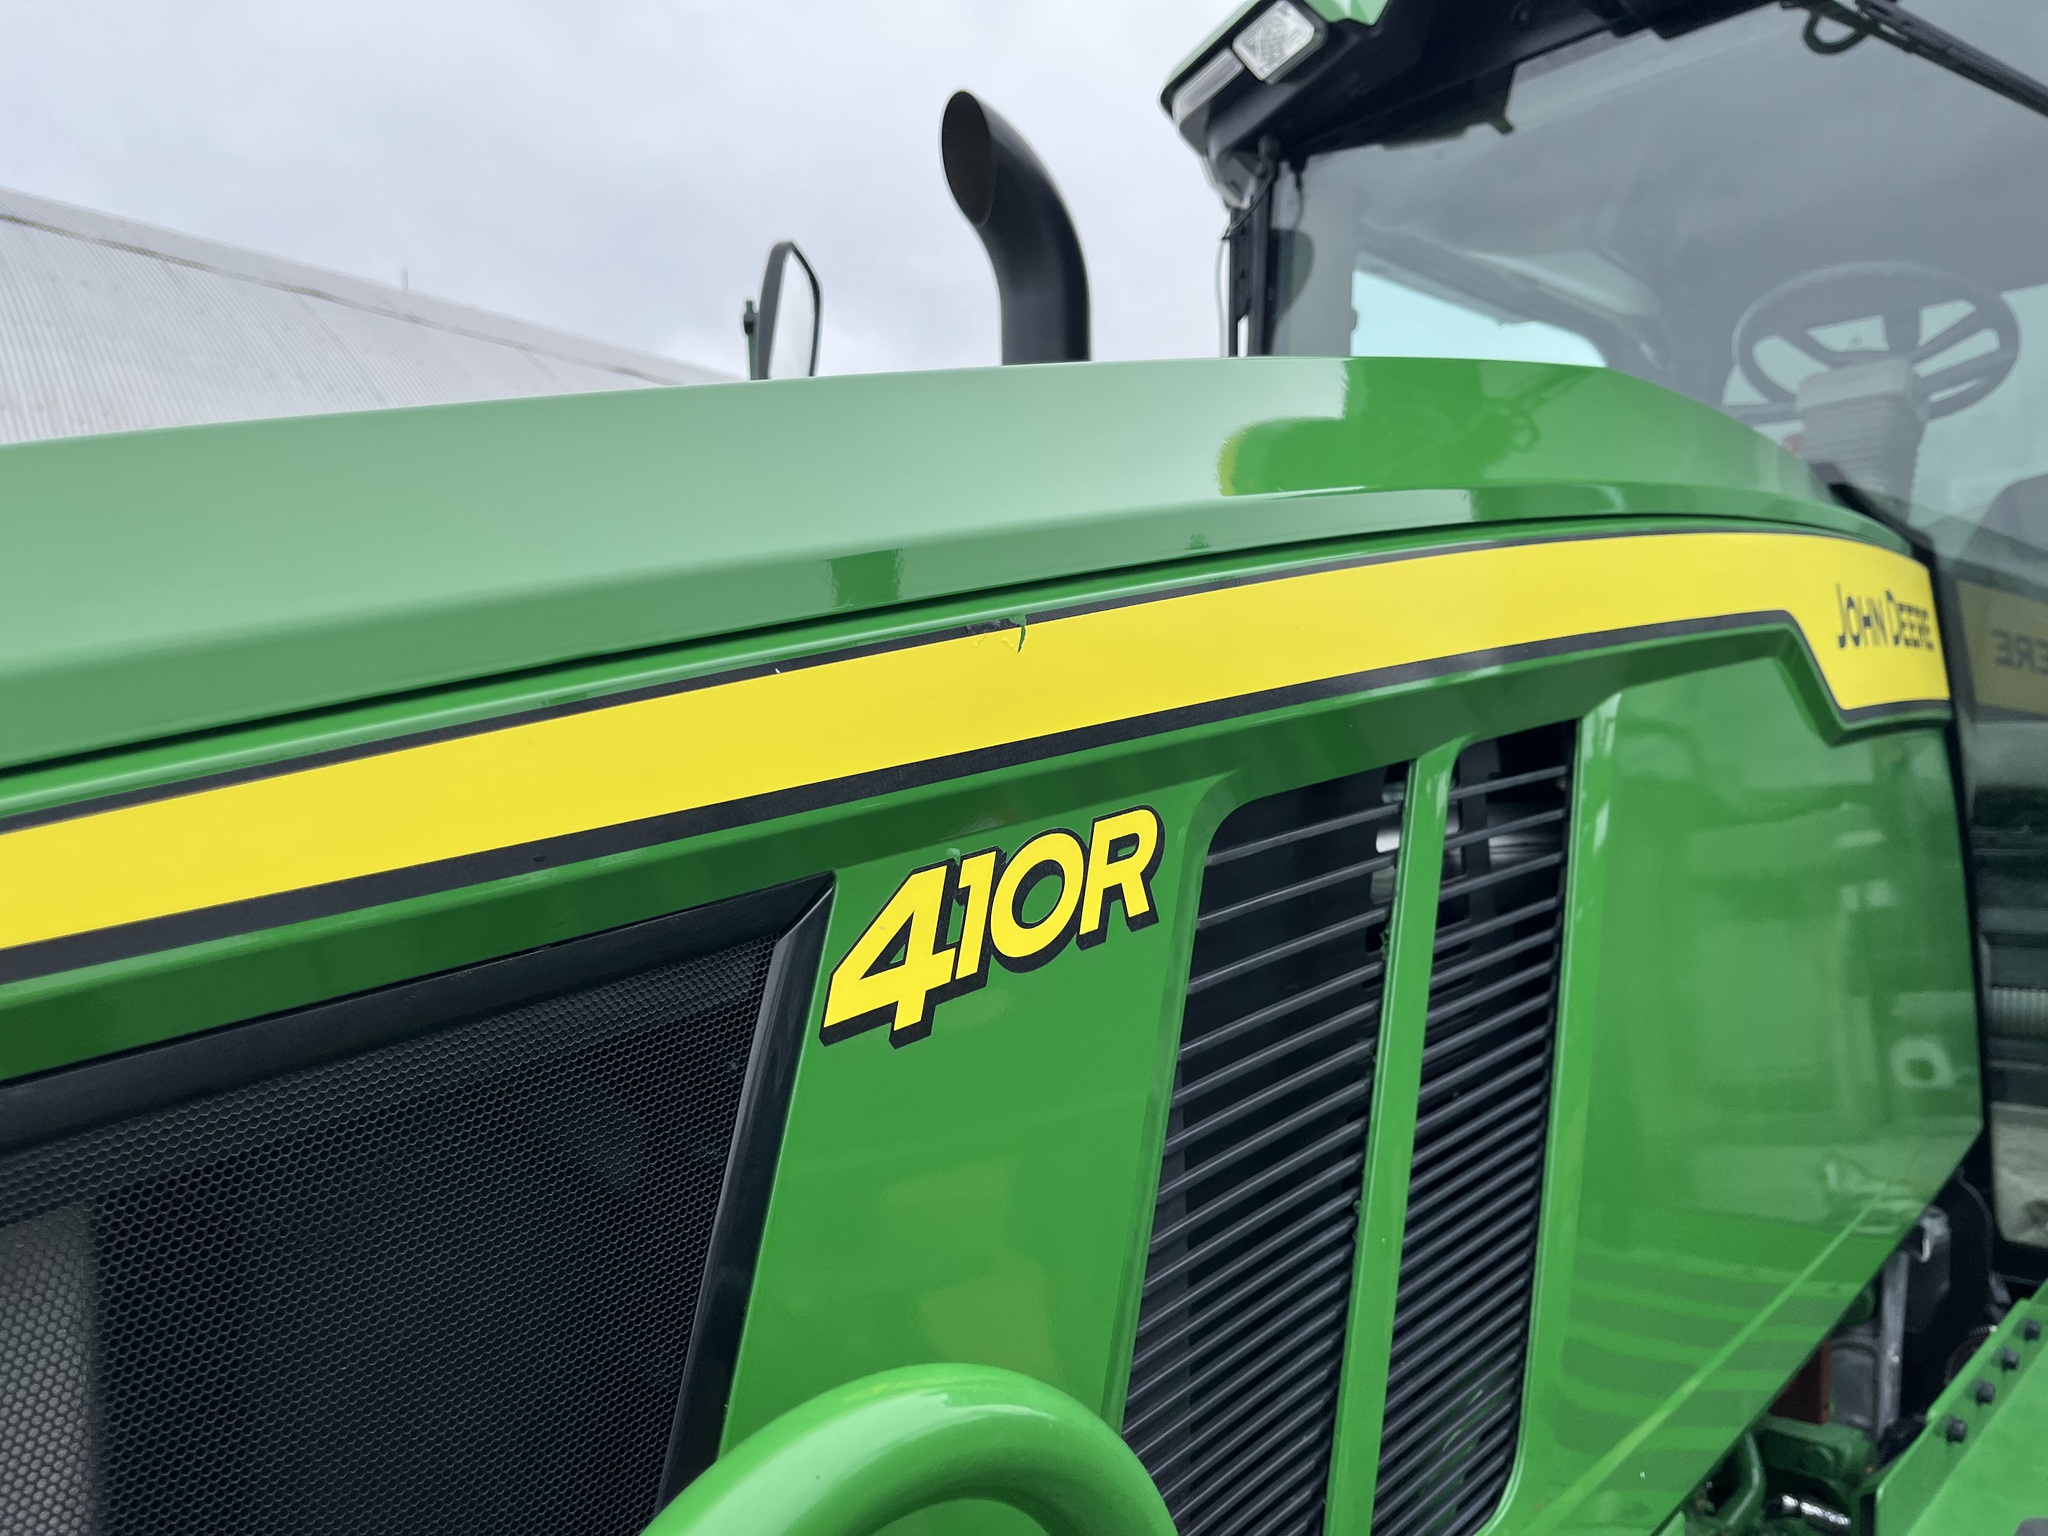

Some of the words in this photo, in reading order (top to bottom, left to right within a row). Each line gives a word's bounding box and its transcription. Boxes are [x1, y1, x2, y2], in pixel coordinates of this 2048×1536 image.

[1836, 583, 1888, 649] JOHN
[1885, 590, 1934, 650] DEERE
[820, 805, 1164, 1048] 410R
